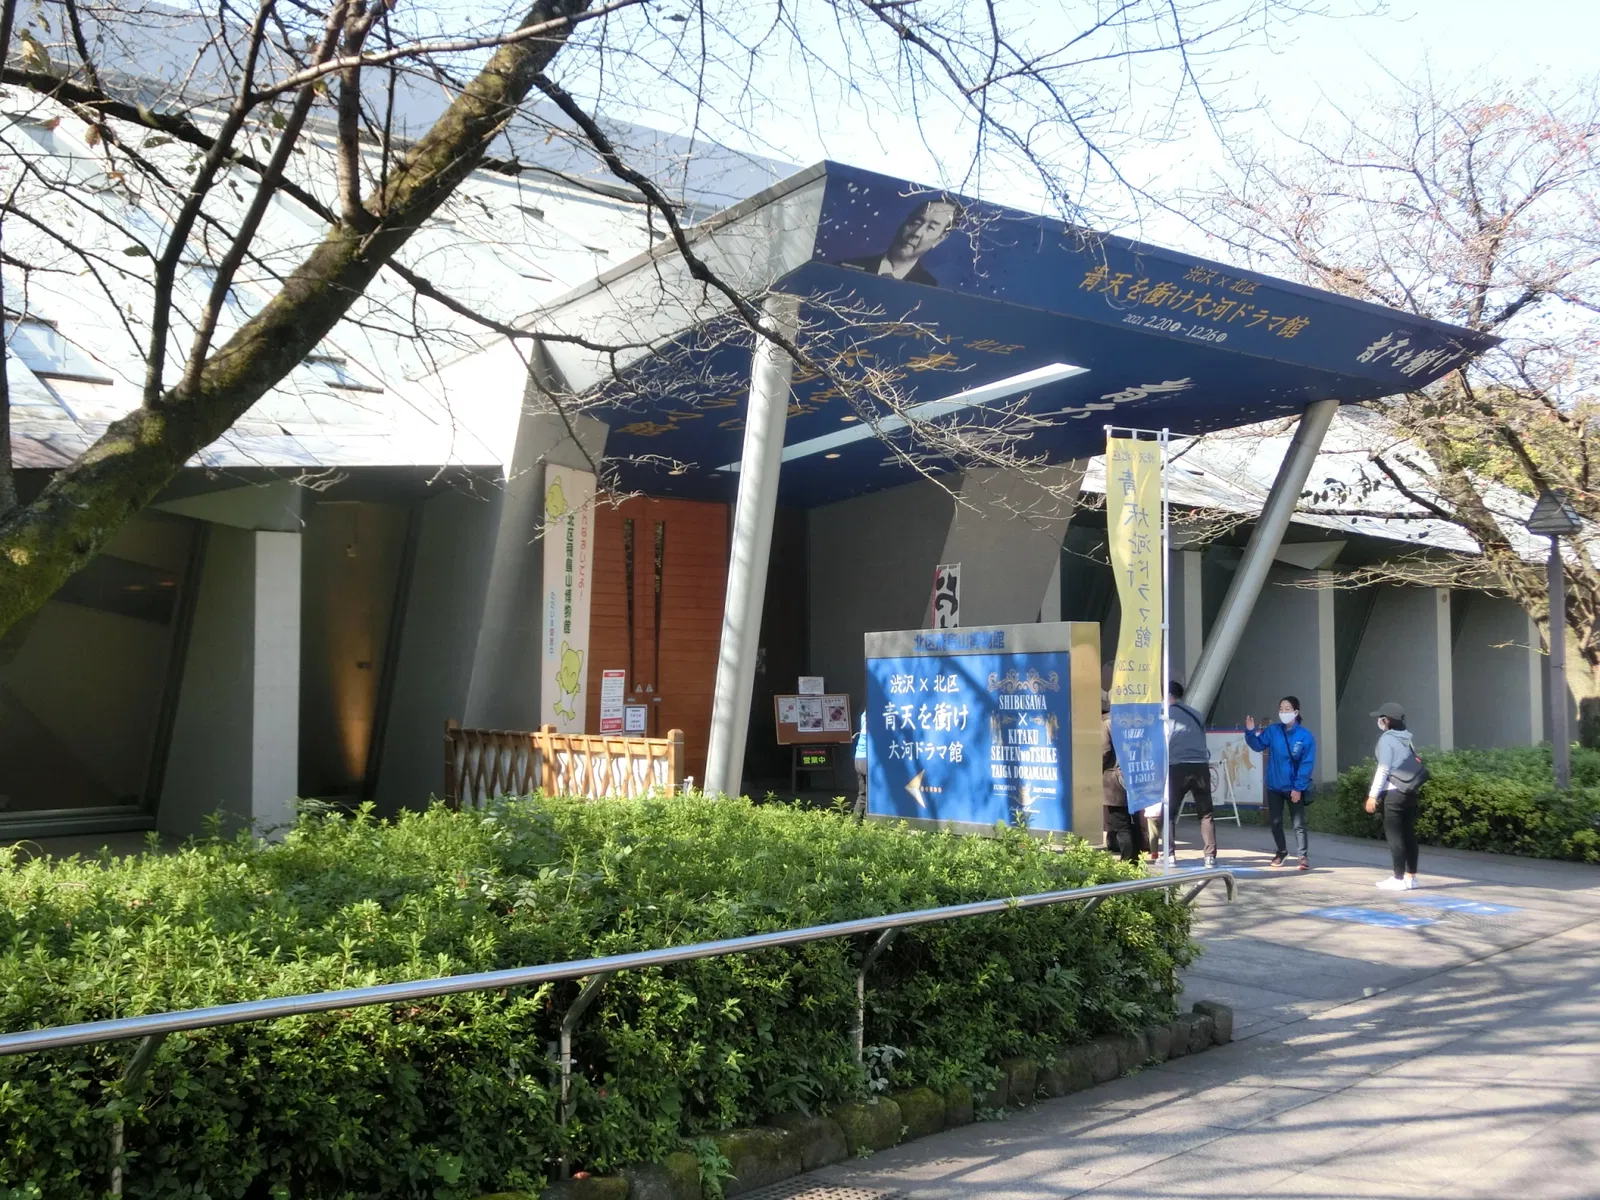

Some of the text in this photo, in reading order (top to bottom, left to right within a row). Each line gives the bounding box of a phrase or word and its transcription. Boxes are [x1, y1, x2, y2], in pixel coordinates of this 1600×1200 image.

[1123, 313, 1143, 326] 2021
[999, 694, 1047, 711] SHIBUSAWA
[882, 703, 969, 732] 青天を衝け
[1008, 729, 1039, 745] KITAKU
[888, 740, 963, 763] 大河ドラマ館
[803, 756, 825, 764] 営業中
[991, 765, 1057, 781] TAIGA DORAMAKAN
